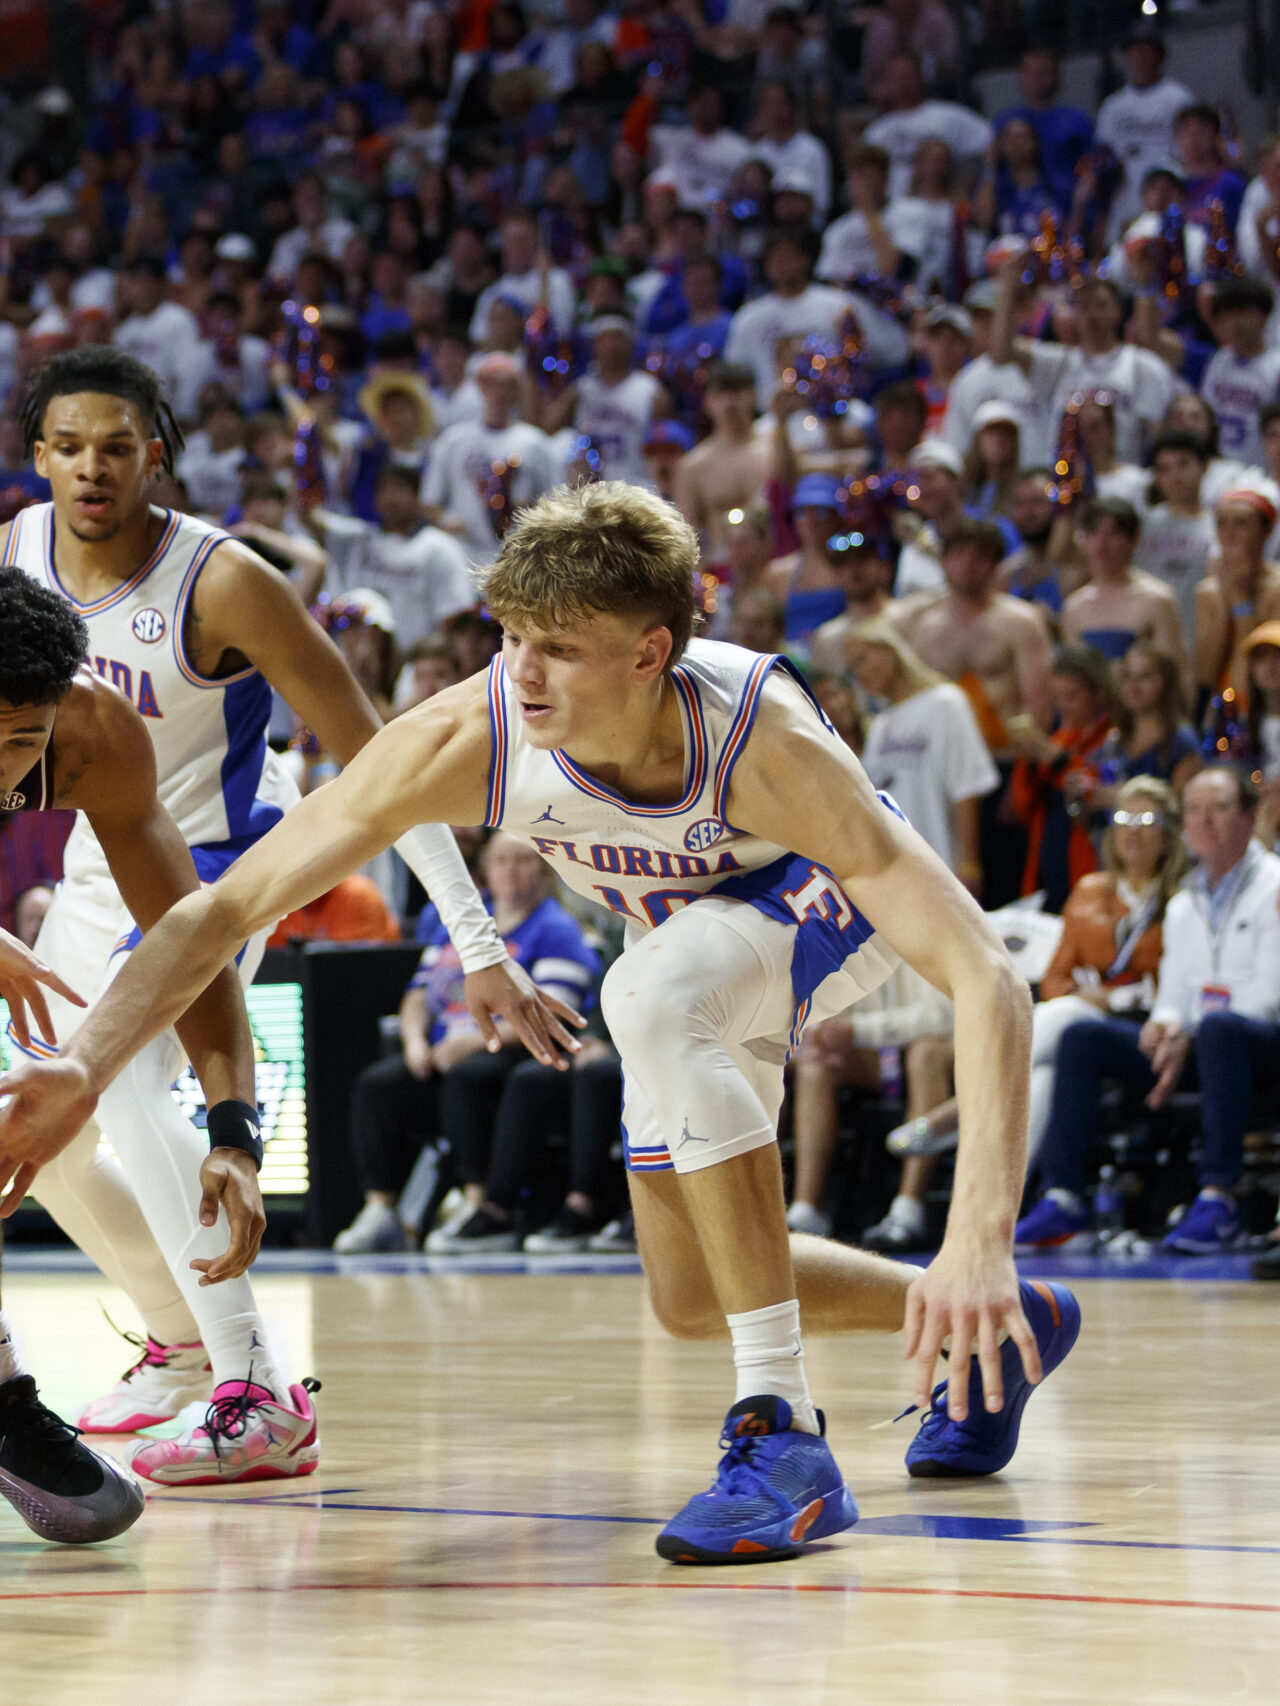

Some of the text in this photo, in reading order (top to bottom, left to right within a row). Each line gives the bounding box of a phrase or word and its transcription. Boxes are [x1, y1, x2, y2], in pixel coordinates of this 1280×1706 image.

[133, 607, 165, 642] SEC
[687, 820, 721, 851] SEC
[530, 836, 746, 879] FLORIDA
[780, 864, 854, 932] F
